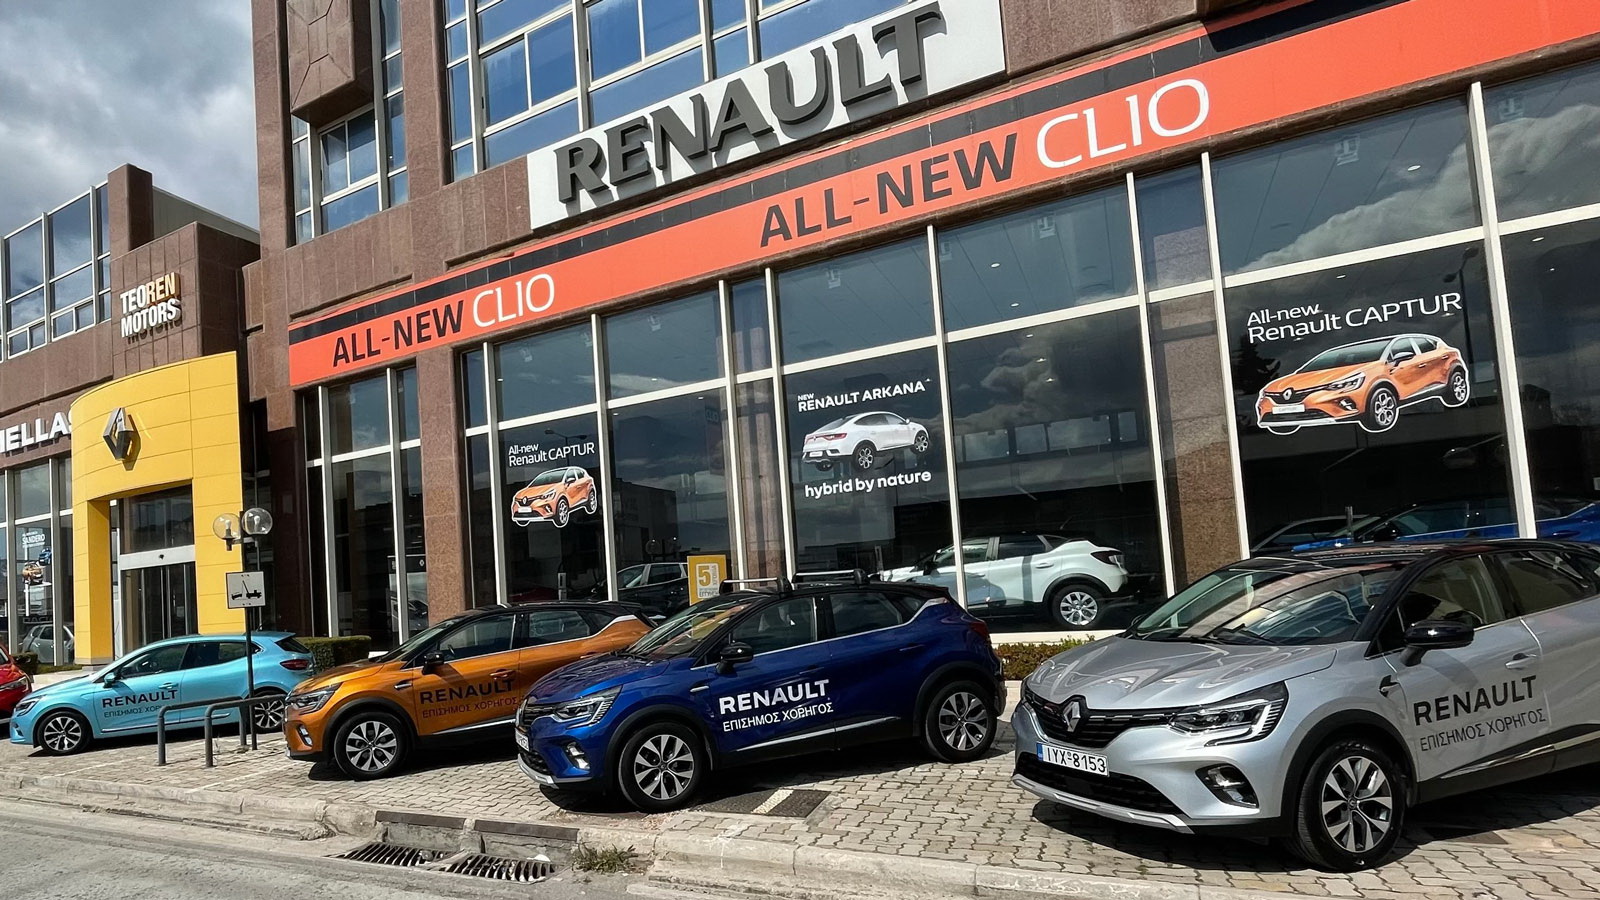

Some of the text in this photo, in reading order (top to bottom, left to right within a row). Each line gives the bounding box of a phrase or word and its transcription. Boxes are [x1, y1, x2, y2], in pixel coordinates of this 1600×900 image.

[554, 1, 941, 203] RENAULT
[760, 78, 1210, 248] ALL-NEW CLIO
[120, 272, 176, 314] TEOREN
[121, 298, 177, 338] MOTORS
[333, 273, 555, 367] ALL-NEW CLIO
[1247, 303, 1320, 327] All-new
[1248, 292, 1462, 343] Renault CAPTUR
[797, 393, 814, 401] NEW
[798, 380, 925, 412] RENAULT ARKANA
[0, 407, 72, 453] ELLA
[508, 443, 539, 456] All-new
[509, 442, 595, 467] Renault CAPTUR
[804, 471, 932, 499] hybrid by nature
[698, 565, 711, 586] 5
[102, 689, 178, 708] RENAULT
[420, 680, 514, 704] RENAULT
[422, 696, 518, 718] ΕΠΙΣΗΜΟΣ ΧΟΡΗΓΟΣ
[720, 679, 829, 714] RENAULT
[1413, 675, 1537, 726] RENAULT
[104, 707, 142, 718] ΕΠΙΣΗΜΟΣ
[723, 702, 834, 732] ΕΠΙΣΗΜΟΣ ΧΟΡΗΓΟΣ
[1420, 708, 1547, 752] ΕΠΙΣΗΜΟΣ ΧΟΡΗΓΟΣ
